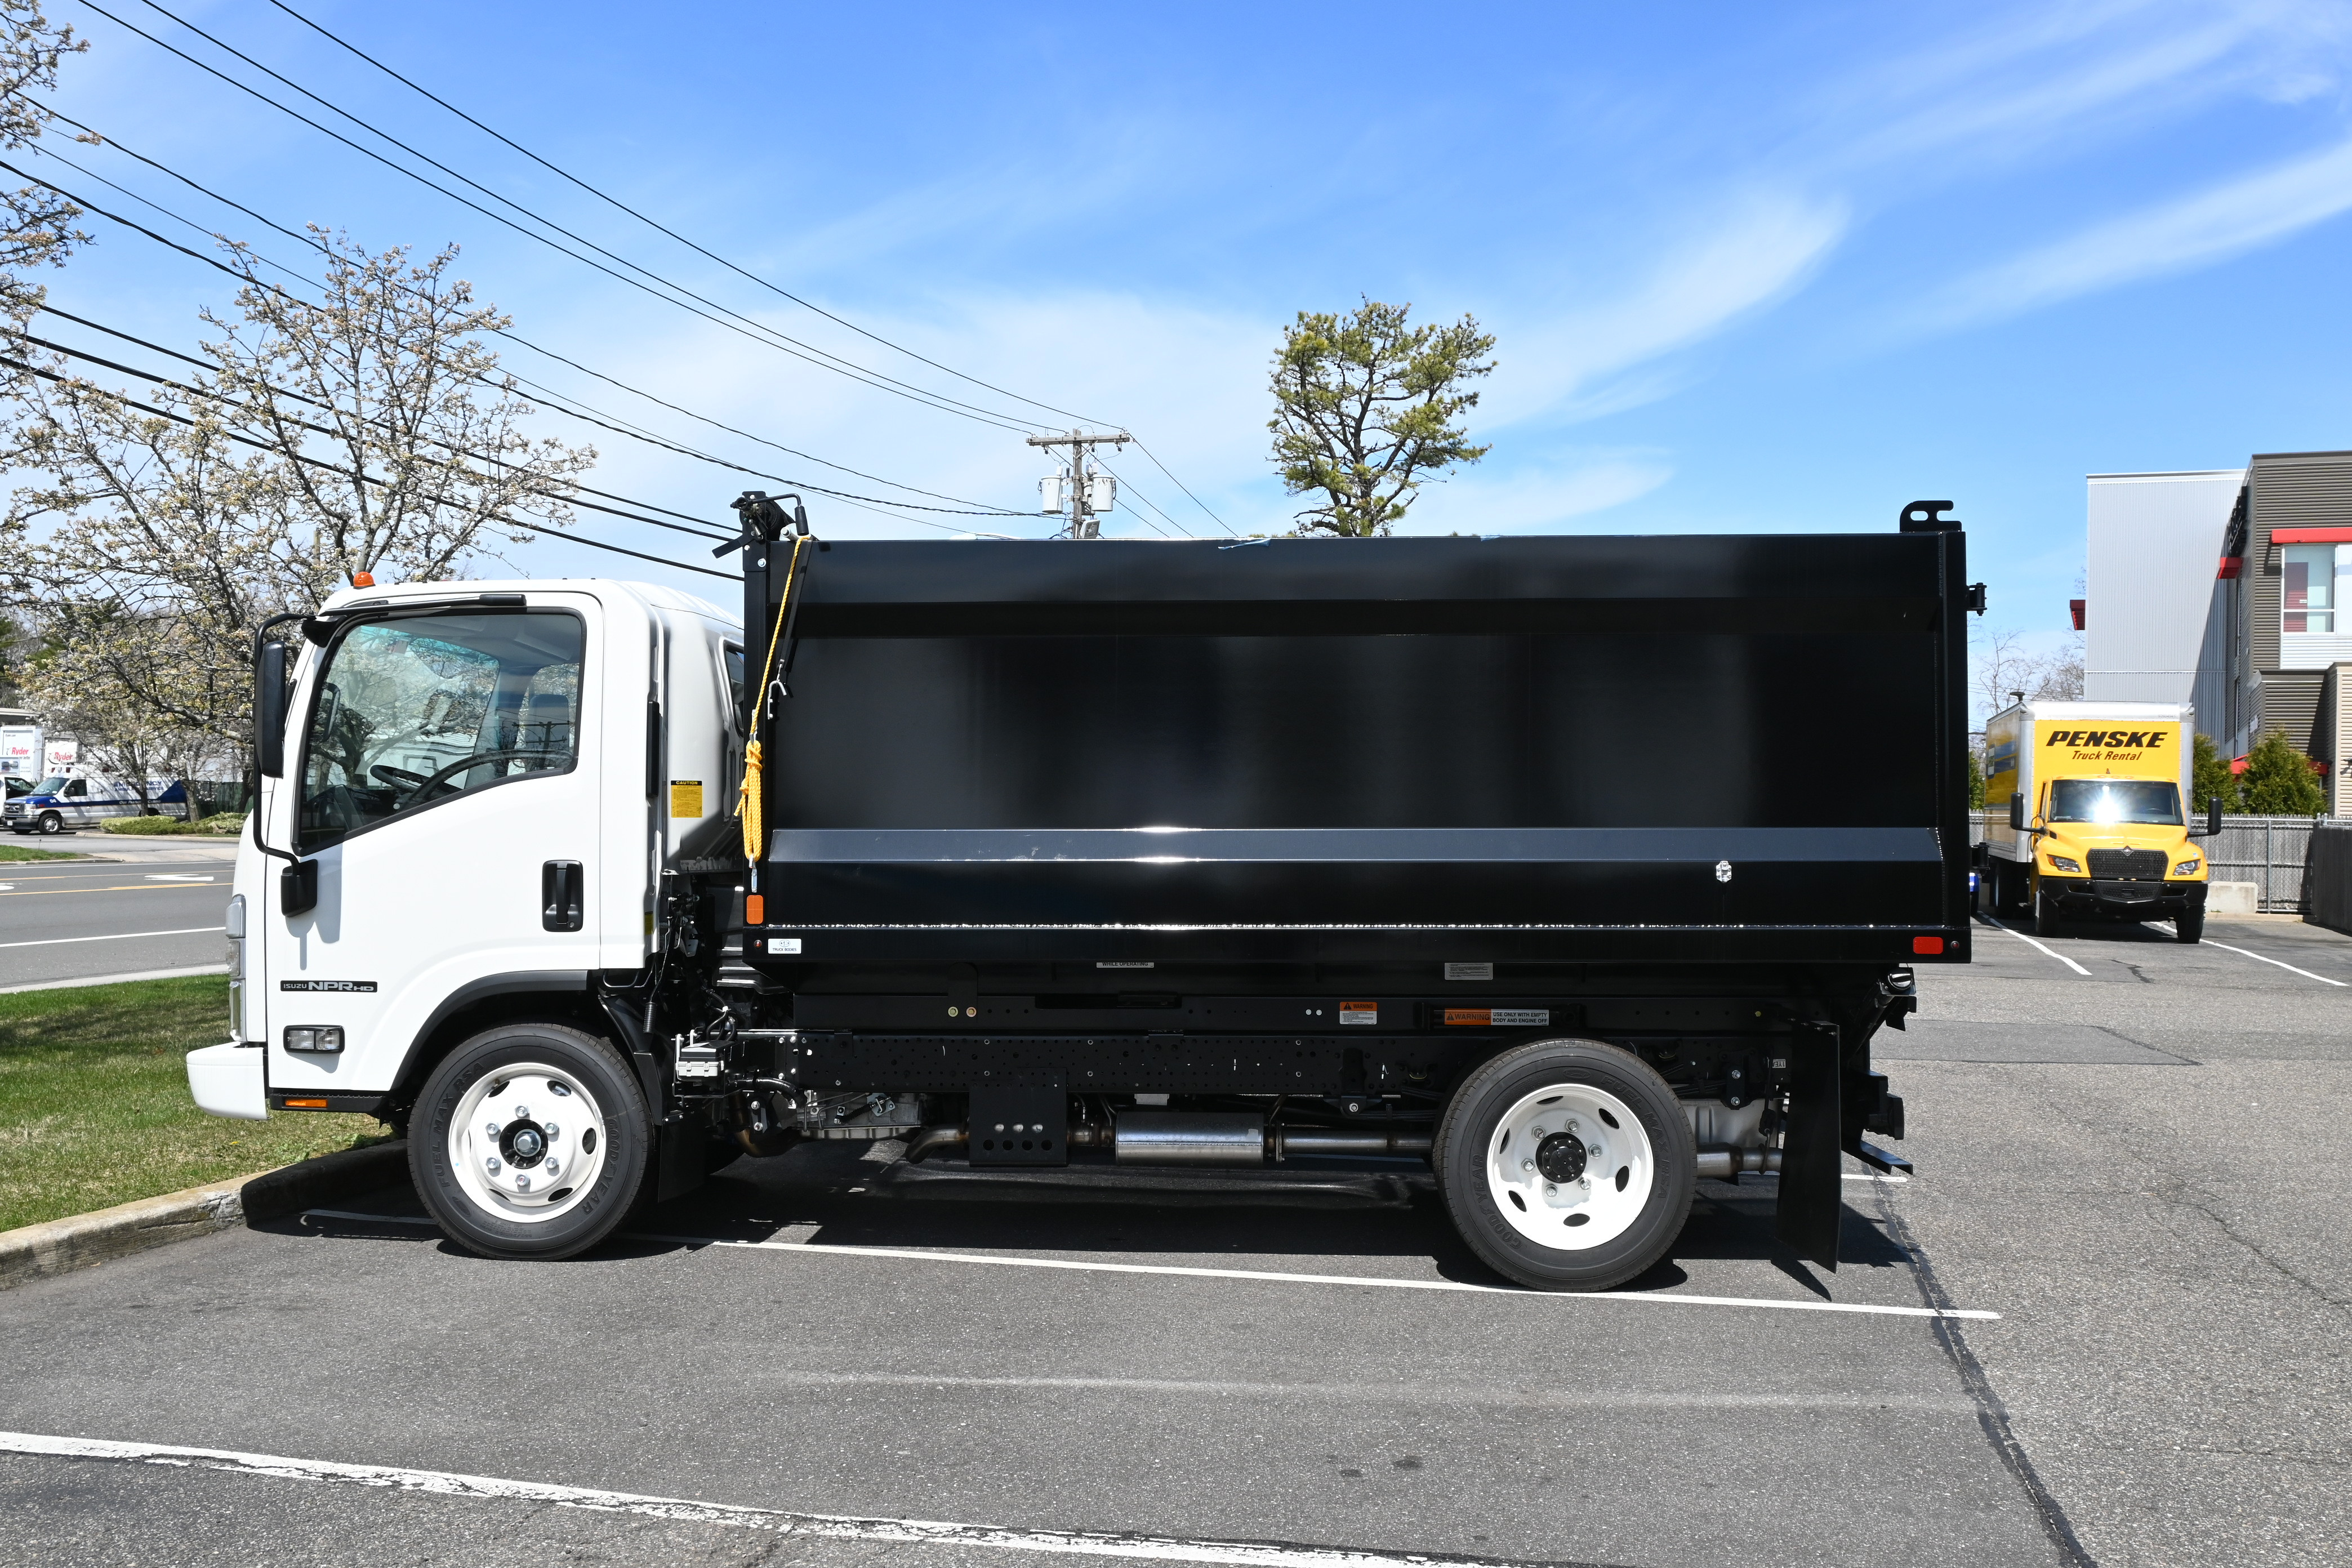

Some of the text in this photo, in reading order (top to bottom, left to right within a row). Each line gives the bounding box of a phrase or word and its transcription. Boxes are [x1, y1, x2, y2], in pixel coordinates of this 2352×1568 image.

[2046, 730, 2168, 747] PENSKE
[11, 747, 29, 755] Ryder
[2072, 751, 2142, 761] Truck Rental
[308, 982, 353, 991] NPR
[1600, 1075, 1643, 1110] FUEL
[1645, 1112, 1669, 1152] MAX
[432, 1062, 484, 1187] FUEL MAX RSA
